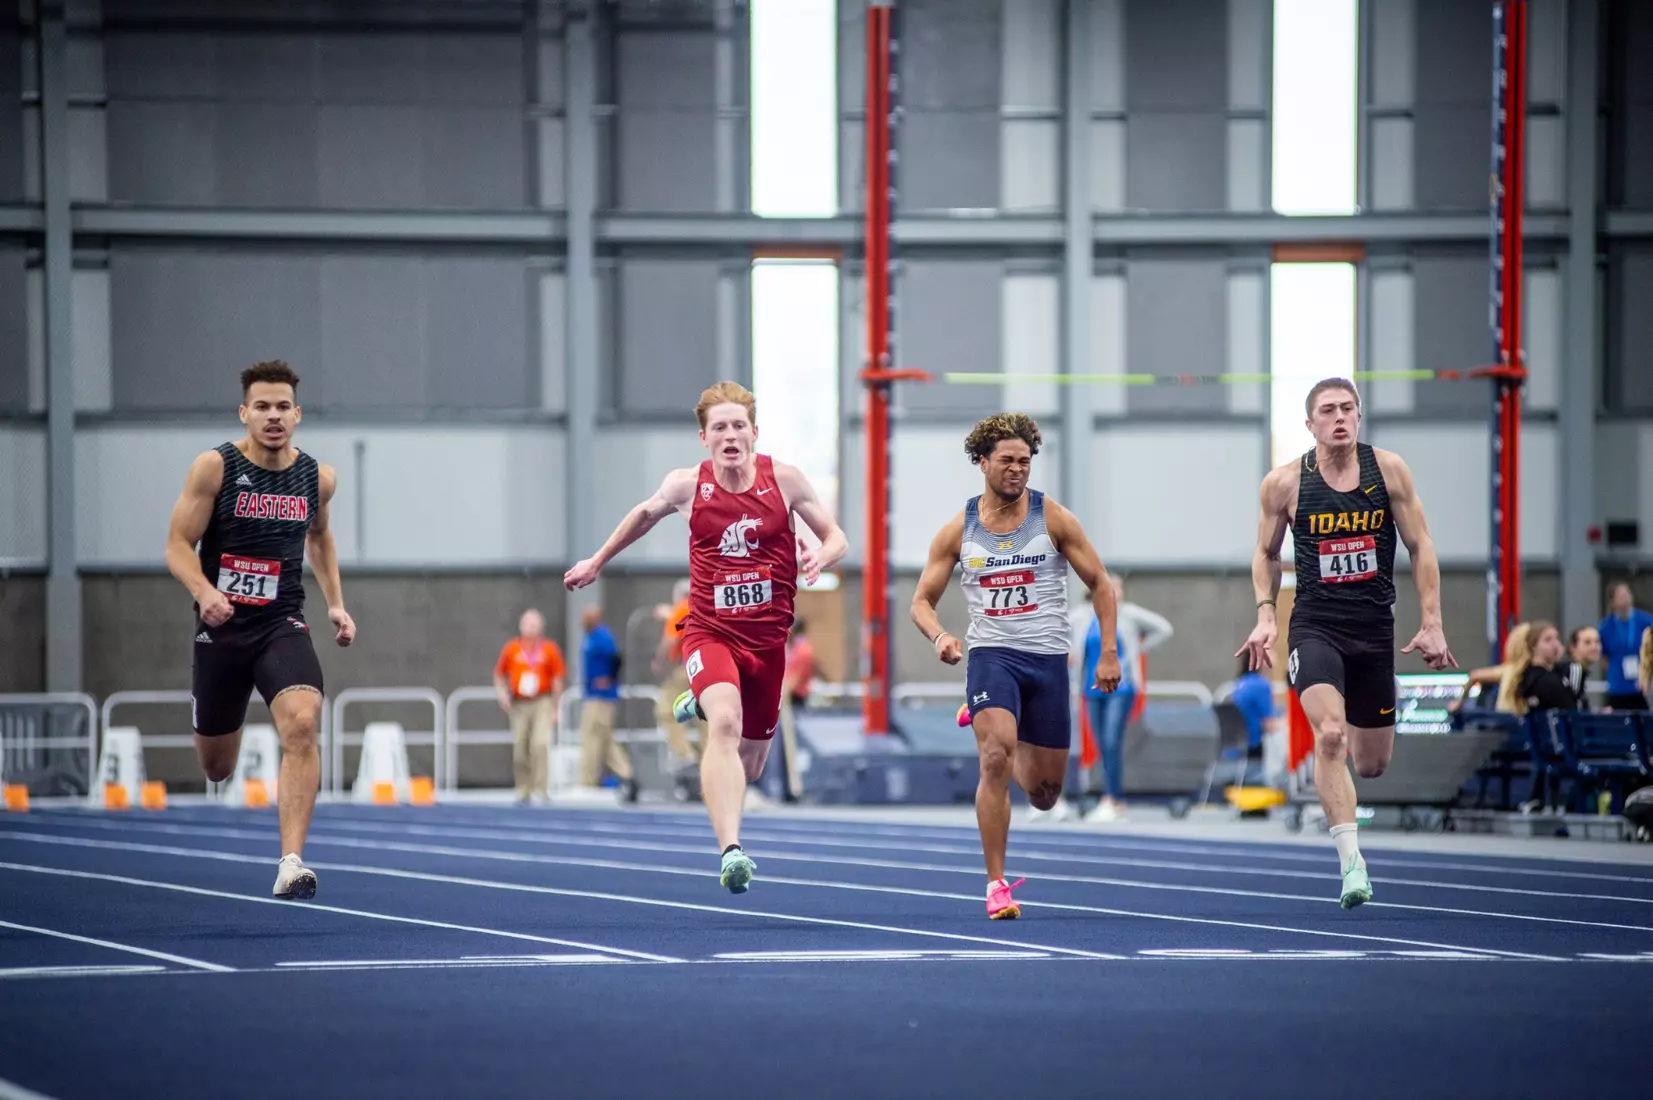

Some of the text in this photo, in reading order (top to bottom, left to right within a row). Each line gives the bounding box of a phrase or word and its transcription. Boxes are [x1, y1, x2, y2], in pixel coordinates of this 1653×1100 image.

[234, 492, 308, 521] EASTERN
[1308, 509, 1385, 534] IDAHO
[1331, 541, 1365, 551] WSU OPEN
[234, 560, 269, 572] WSU OPEN
[1330, 552, 1368, 575] 416
[227, 571, 266, 597] 251
[725, 572, 760, 582] WSU OPEN
[991, 575, 1024, 585] WSU OPEN
[724, 583, 764, 607] 868
[989, 586, 1029, 608] 773
